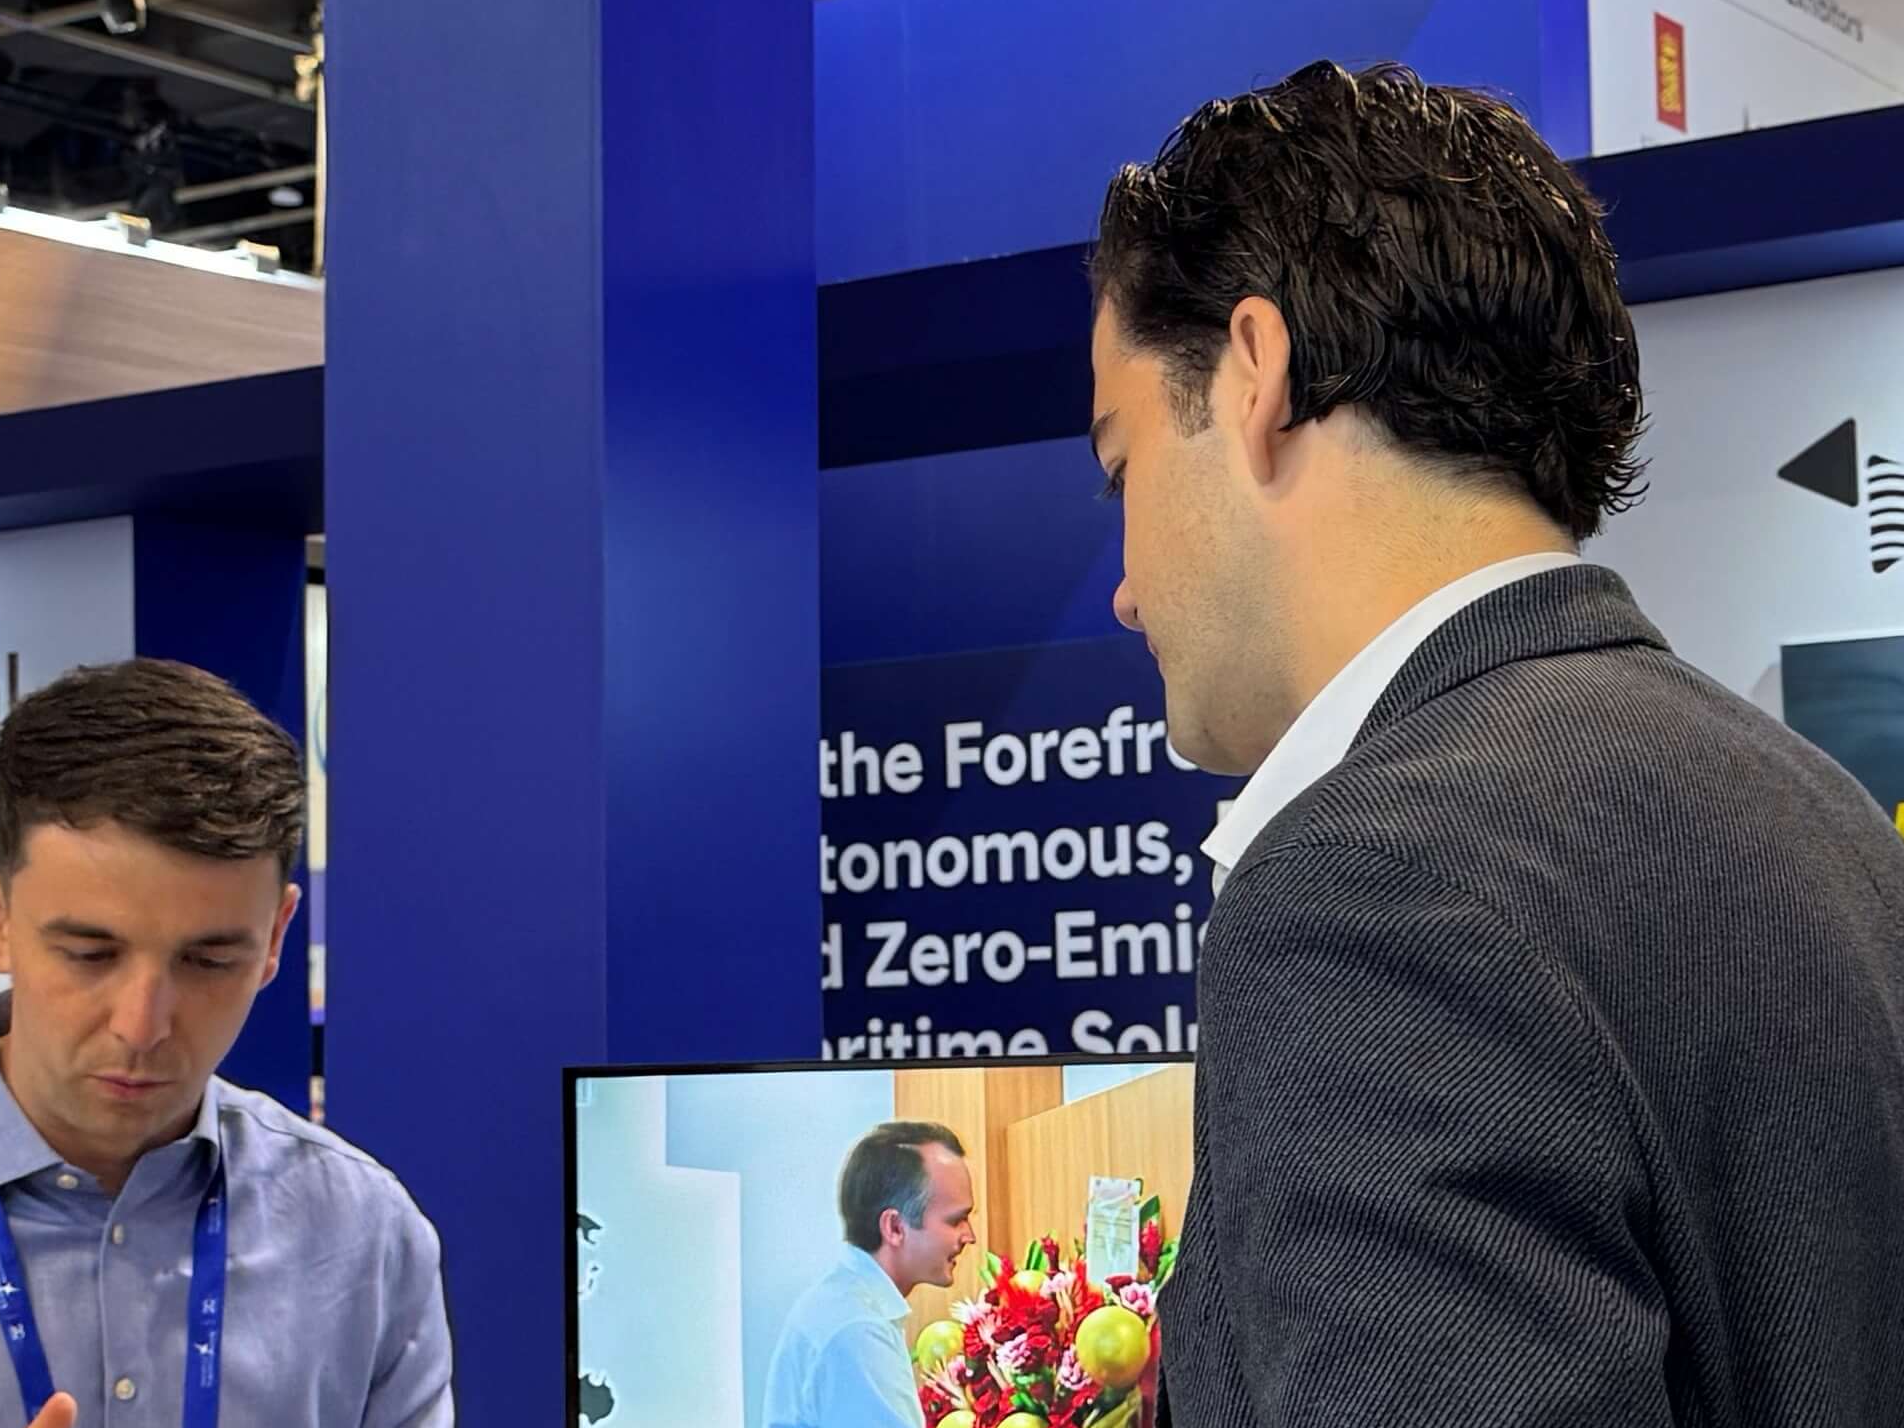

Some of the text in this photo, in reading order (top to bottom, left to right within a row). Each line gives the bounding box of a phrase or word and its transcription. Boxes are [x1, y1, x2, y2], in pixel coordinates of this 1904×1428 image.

[819, 705, 1200, 799] the Forefr
[819, 819, 1194, 895] tonomous,
[821, 1016, 1049, 1062] ritime
